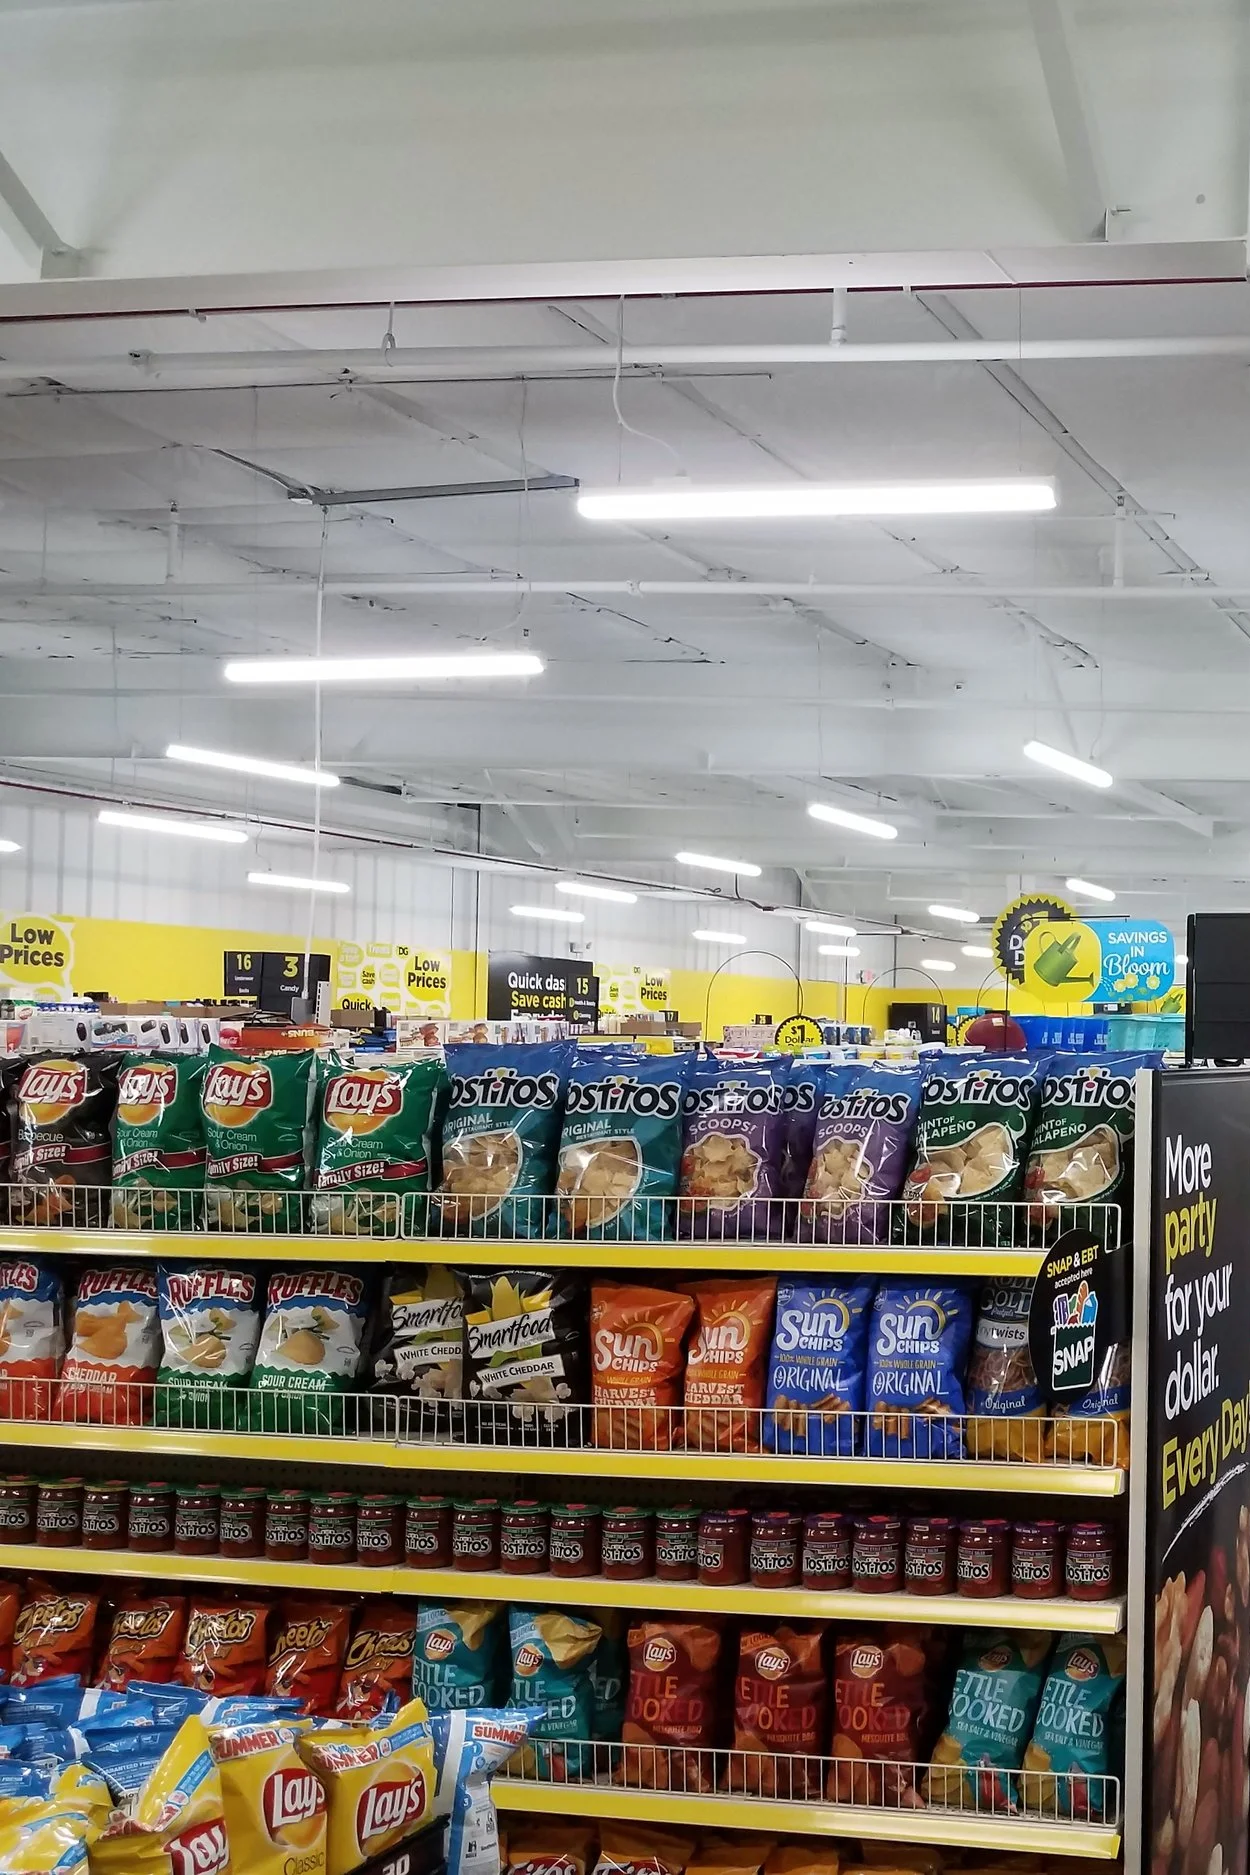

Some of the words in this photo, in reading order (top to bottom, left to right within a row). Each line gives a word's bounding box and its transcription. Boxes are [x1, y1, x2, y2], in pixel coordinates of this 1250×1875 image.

[11, 923, 54, 945] Low
[1108, 931, 1167, 944] SAVINGS
[0, 945, 64, 967] Prices
[398, 947, 409, 955] DG
[1130, 945, 1144, 957] IN
[236, 954, 252, 970] 16
[283, 956, 299, 978] 3
[414, 956, 440, 972] Low
[1103, 953, 1170, 976] Bloom
[362, 970, 375, 978] Save
[407, 972, 446, 988] Prices
[508, 972, 543, 991] Quick
[545, 974, 566, 991] das
[645, 974, 662, 987] Low
[279, 985, 300, 993] Candy
[576, 978, 589, 995] 15
[640, 987, 667, 1001] Prices
[341, 998, 372, 1011] Quick
[511, 990, 540, 1007] Save
[542, 993, 566, 1008] cash
[667, 1011, 673, 1022] 17
[932, 1006, 941, 1023] 14
[18, 1067, 84, 1104] Lay's
[206, 1067, 267, 1106] Lay's
[327, 1077, 397, 1115] Lay's
[614, 1126, 635, 1135] STYLE
[688, 1119, 758, 1137] SCOOPS!
[917, 1118, 944, 1135] HINT
[944, 1116, 956, 1126] OF
[1056, 1117, 1067, 1127] OF
[135, 1128, 158, 1138] Cream
[207, 1127, 224, 1139] Sour
[226, 1130, 257, 1142] Cream
[221, 1141, 248, 1150] Onion
[351, 1137, 383, 1149] Cream
[36, 1146, 66, 1161] Size!
[343, 1148, 372, 1158] Onion
[232, 1154, 258, 1171] Size!
[353, 1162, 385, 1179] Size!
[1165, 1134, 1212, 1199] More
[1165, 1191, 1217, 1276] party
[1047, 1256, 1072, 1278] SNAP
[1073, 1253, 1080, 1268] &
[1081, 1244, 1099, 1265] EBT
[78, 1267, 159, 1300] RUFFLES
[1054, 1272, 1080, 1289] accepted
[1080, 1266, 1093, 1278] here
[166, 1269, 256, 1310] RUFFLES
[267, 1269, 365, 1306] RUFFLES
[1165, 1273, 1191, 1341] for
[1195, 1262, 1233, 1336] your
[468, 1310, 554, 1353] Smartfood
[776, 1308, 849, 1351] Sun
[876, 1313, 943, 1356] Sun
[399, 1347, 430, 1361] WHITE
[432, 1345, 462, 1358] CHEDD
[594, 1328, 662, 1371] Sun
[688, 1325, 748, 1365] Sun
[799, 1337, 844, 1352] CHIPS
[896, 1340, 940, 1354] CHIPS
[703, 1349, 745, 1366] CHIPS
[795, 1356, 815, 1366] WHOLE
[816, 1357, 838, 1366] GRAIN
[894, 1359, 914, 1369] WHOLE
[915, 1360, 936, 1369] GRAIN
[1053, 1335, 1093, 1376] SNAP
[481, 1369, 507, 1384] WHITE
[508, 1360, 555, 1377] CHEDDAR
[611, 1357, 657, 1373] CHIPS
[262, 1374, 287, 1388] SOUR
[288, 1376, 326, 1392] CREAM
[774, 1366, 849, 1392] ORIGINAL
[872, 1369, 949, 1396] ORIGINAL
[1165, 1341, 1220, 1421] dollar.
[594, 1386, 657, 1398] HARVEST
[985, 1396, 1026, 1414] Original
[1162, 1415, 1219, 1510] Every
[804, 1554, 849, 1571] TOSTITOS
[516, 1648, 542, 1667] Lay's
[645, 1644, 673, 1662] Lay's
[852, 1650, 881, 1668] Lay's
[757, 1654, 788, 1671] Lay's
[1068, 1653, 1099, 1675] Lay's
[272, 1772, 326, 1828] Lay's
[361, 1778, 423, 1840] Lay's
[283, 1851, 325, 1875] Classic
